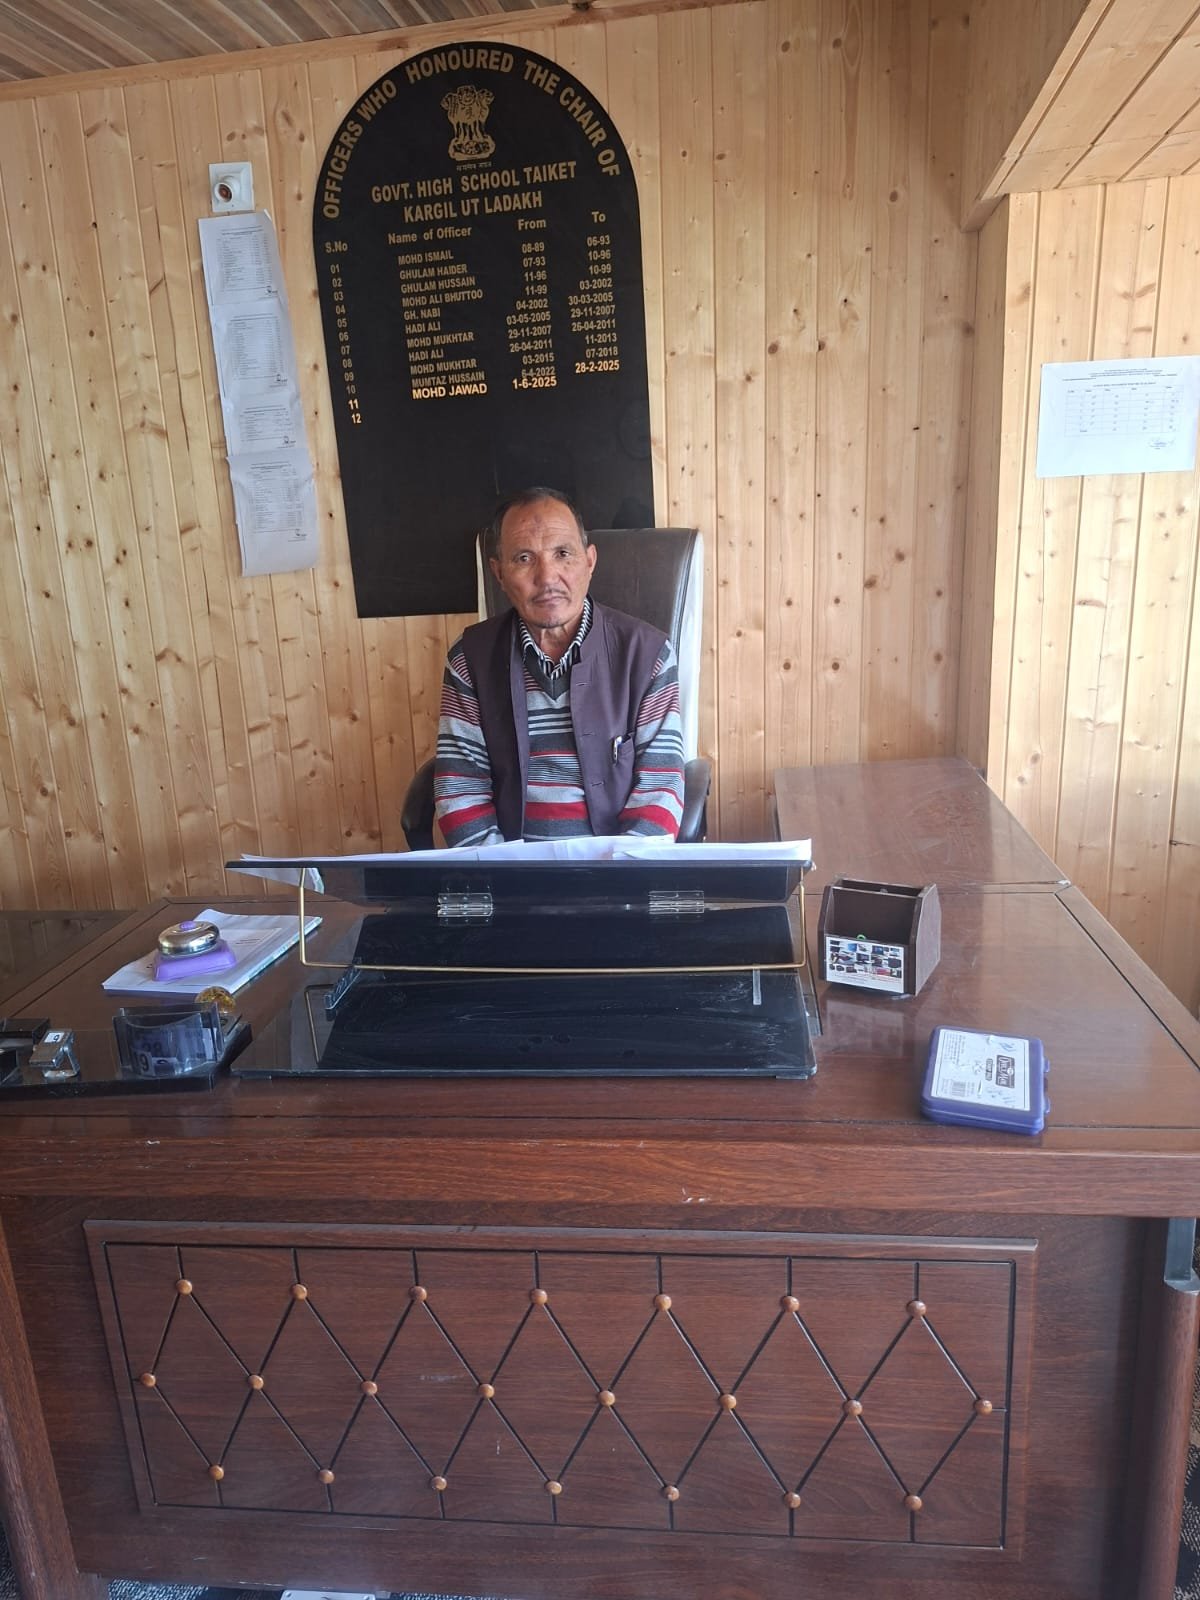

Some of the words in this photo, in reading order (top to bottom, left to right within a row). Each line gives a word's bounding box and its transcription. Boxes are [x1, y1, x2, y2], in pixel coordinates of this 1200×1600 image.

[322, 120, 363, 218] OFFICERS
[357, 80, 397, 122] WHO
[406, 48, 514, 84] HONOURED
[524, 60, 560, 94] THE
[559, 87, 607, 149] CHAIR
[597, 148, 621, 177] OF
[371, 183, 413, 203] GOVT.
[416, 178, 454, 196] HIGH
[460, 169, 520, 193] SCHOOL
[523, 161, 577, 183] TAIKET
[404, 200, 457, 223] KARGIL
[461, 197, 480, 215] UT
[484, 191, 542, 212] LADAKH
[325, 241, 348, 253] S.No
[388, 232, 417, 245] Name
[423, 228, 434, 241] of
[437, 226, 472, 239] Officer
[517, 218, 547, 231] From
[591, 211, 606, 223] To
[330, 264, 340, 273] 01
[398, 254, 423, 265] MOHD
[425, 250, 454, 262] ISMAIL
[521, 241, 545, 253] 08-89
[332, 278, 343, 288] 02
[400, 267, 435, 280] GHULAM
[437, 263, 468, 276] HAIDER
[523, 256, 546, 268] 07-93
[588, 249, 611, 261] 10-96
[334, 291, 344, 301] 03
[400, 280, 436, 293] GHULAM
[438, 276, 476, 290] HUSSAIN
[524, 270, 547, 282] 11-96
[589, 264, 611, 275] 10-99
[335, 305, 346, 315] 04
[402, 295, 427, 307] MOHD
[429, 293, 443, 304] ALI
[444, 289, 483, 303] BHUTTOO
[525, 284, 548, 296] 11-99
[579, 278, 613, 290] 03-2002
[337, 318, 347, 328] 05
[404, 310, 418, 321] GH.
[420, 307, 441, 318] NABI
[516, 298, 549, 310] 04-2002
[568, 292, 613, 306] 30-03-2005
[339, 332, 349, 342] 06
[405, 323, 425, 334] HADI
[428, 321, 441, 332] ALI
[506, 311, 551, 326] 03-05-2005
[570, 304, 615, 318] 29-11-2007
[341, 345, 350, 355] 07
[407, 337, 431, 348] MOHD
[433, 332, 475, 345] MUKHTAR
[508, 325, 552, 339] 29-11-2007
[571, 319, 616, 332] 26-04-2011
[342, 358, 353, 368] 08
[408, 351, 429, 362] HADI
[431, 349, 444, 359] ALI
[510, 339, 553, 353] 26-04-2011
[585, 333, 617, 345] 11-2013
[344, 372, 354, 382] 09
[410, 364, 435, 375] MOHD
[436, 358, 477, 372] MUKHTAR
[522, 352, 555, 365] 03-2015
[346, 384, 356, 394] 10
[412, 375, 447, 388] MUMTAZ
[449, 371, 485, 384] HUSSAIN
[575, 360, 620, 373] 28-2-2025
[348, 399, 359, 410] 11
[412, 386, 446, 400] MOHD
[449, 383, 487, 396] JAWAD
[512, 376, 557, 390] 1-6-2025
[352, 413, 362, 424] 12
